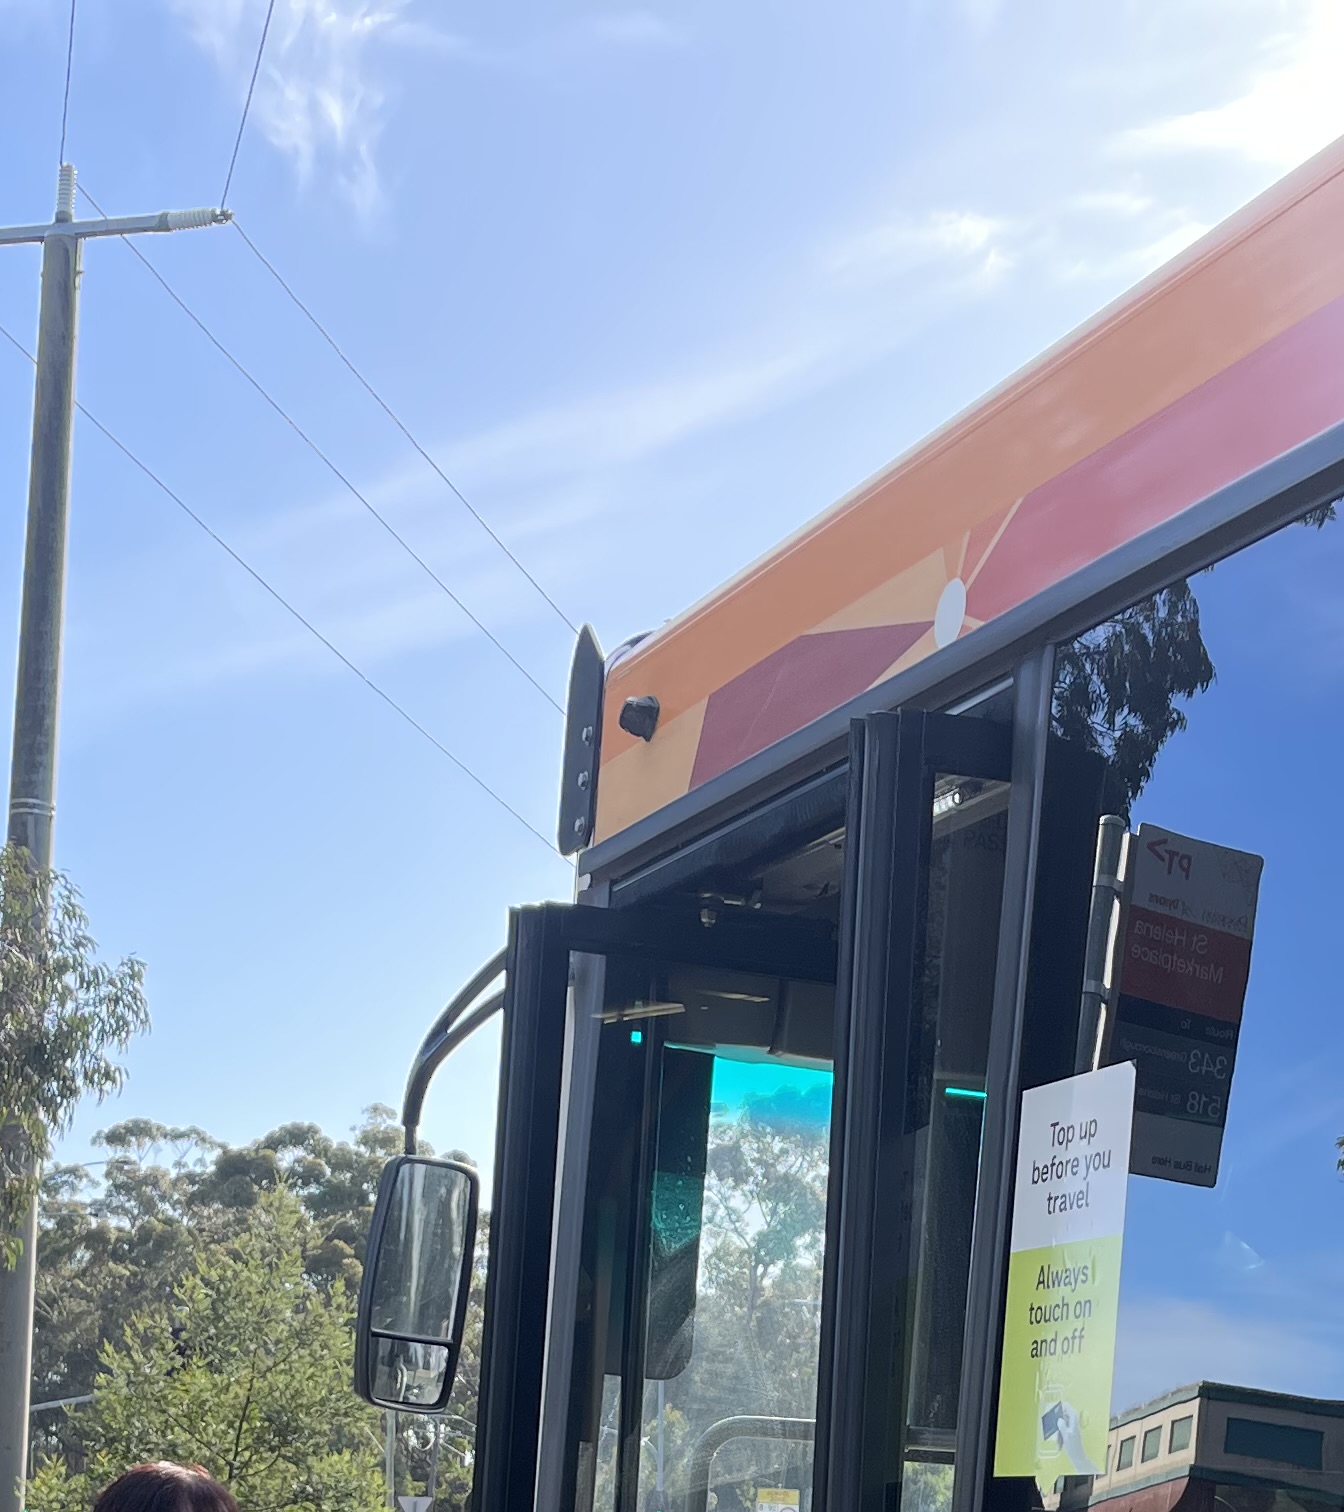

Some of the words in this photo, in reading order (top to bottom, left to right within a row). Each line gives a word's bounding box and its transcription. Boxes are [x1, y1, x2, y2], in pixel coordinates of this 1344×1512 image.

[1050, 1121, 1075, 1151] Top
[1079, 1118, 1098, 1145] up
[1031, 1155, 1080, 1185] before
[1083, 1149, 1112, 1181] you
[1047, 1181, 1089, 1215] travel
[1036, 1264, 1089, 1293] Always
[1029, 1296, 1069, 1325] touch
[1074, 1299, 1092, 1319] on
[1030, 1330, 1058, 1358] and
[1061, 1327, 1085, 1355] off
